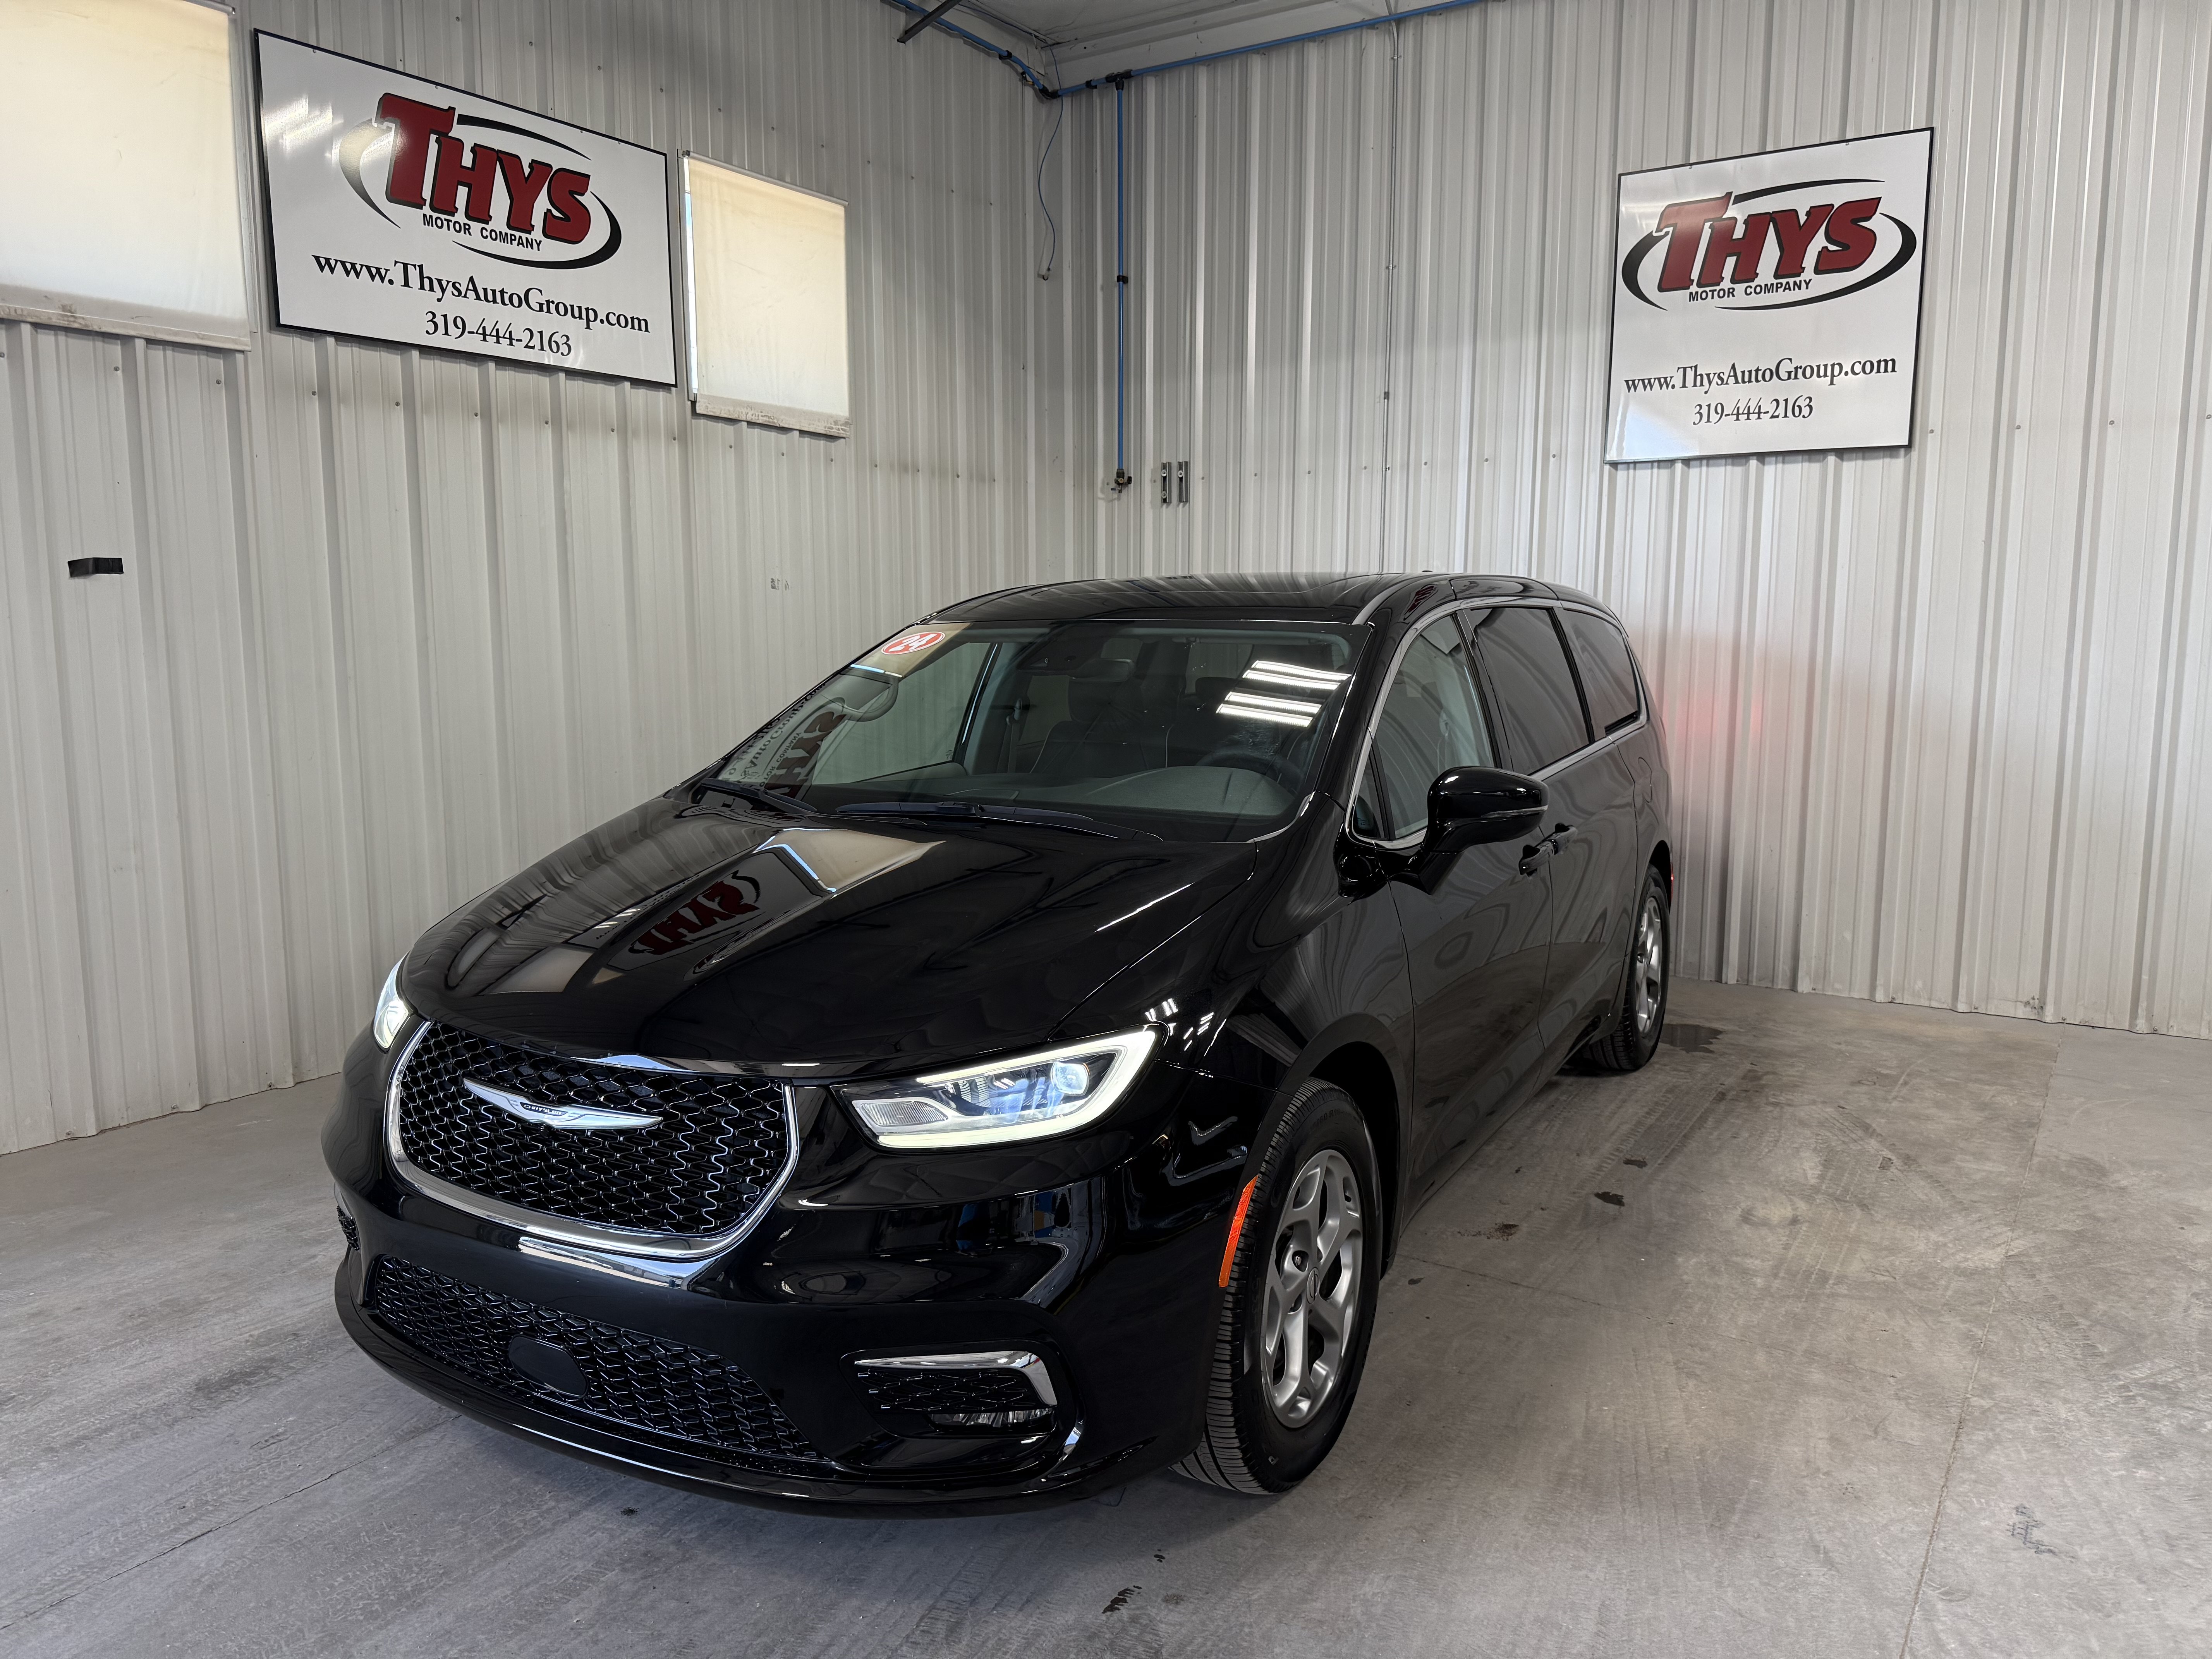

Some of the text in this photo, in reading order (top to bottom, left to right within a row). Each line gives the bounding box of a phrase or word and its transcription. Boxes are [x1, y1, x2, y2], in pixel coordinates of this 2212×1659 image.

[376, 93, 591, 244] THYS
[423, 213, 542, 251] MOTOR COMPANY
[1654, 191, 1882, 292] THYS
[312, 255, 650, 333] www.ThysAutoGroup.com
[1689, 279, 1812, 302] MOTOR COMPANY
[426, 311, 571, 356] 319-444-2163
[1625, 359, 1896, 394] www.ThysAutoGroup.com
[1693, 395, 1813, 425] 319-444-2163
[888, 634, 937, 652] 24
[524, 1104, 562, 1115] CHRYSLER
